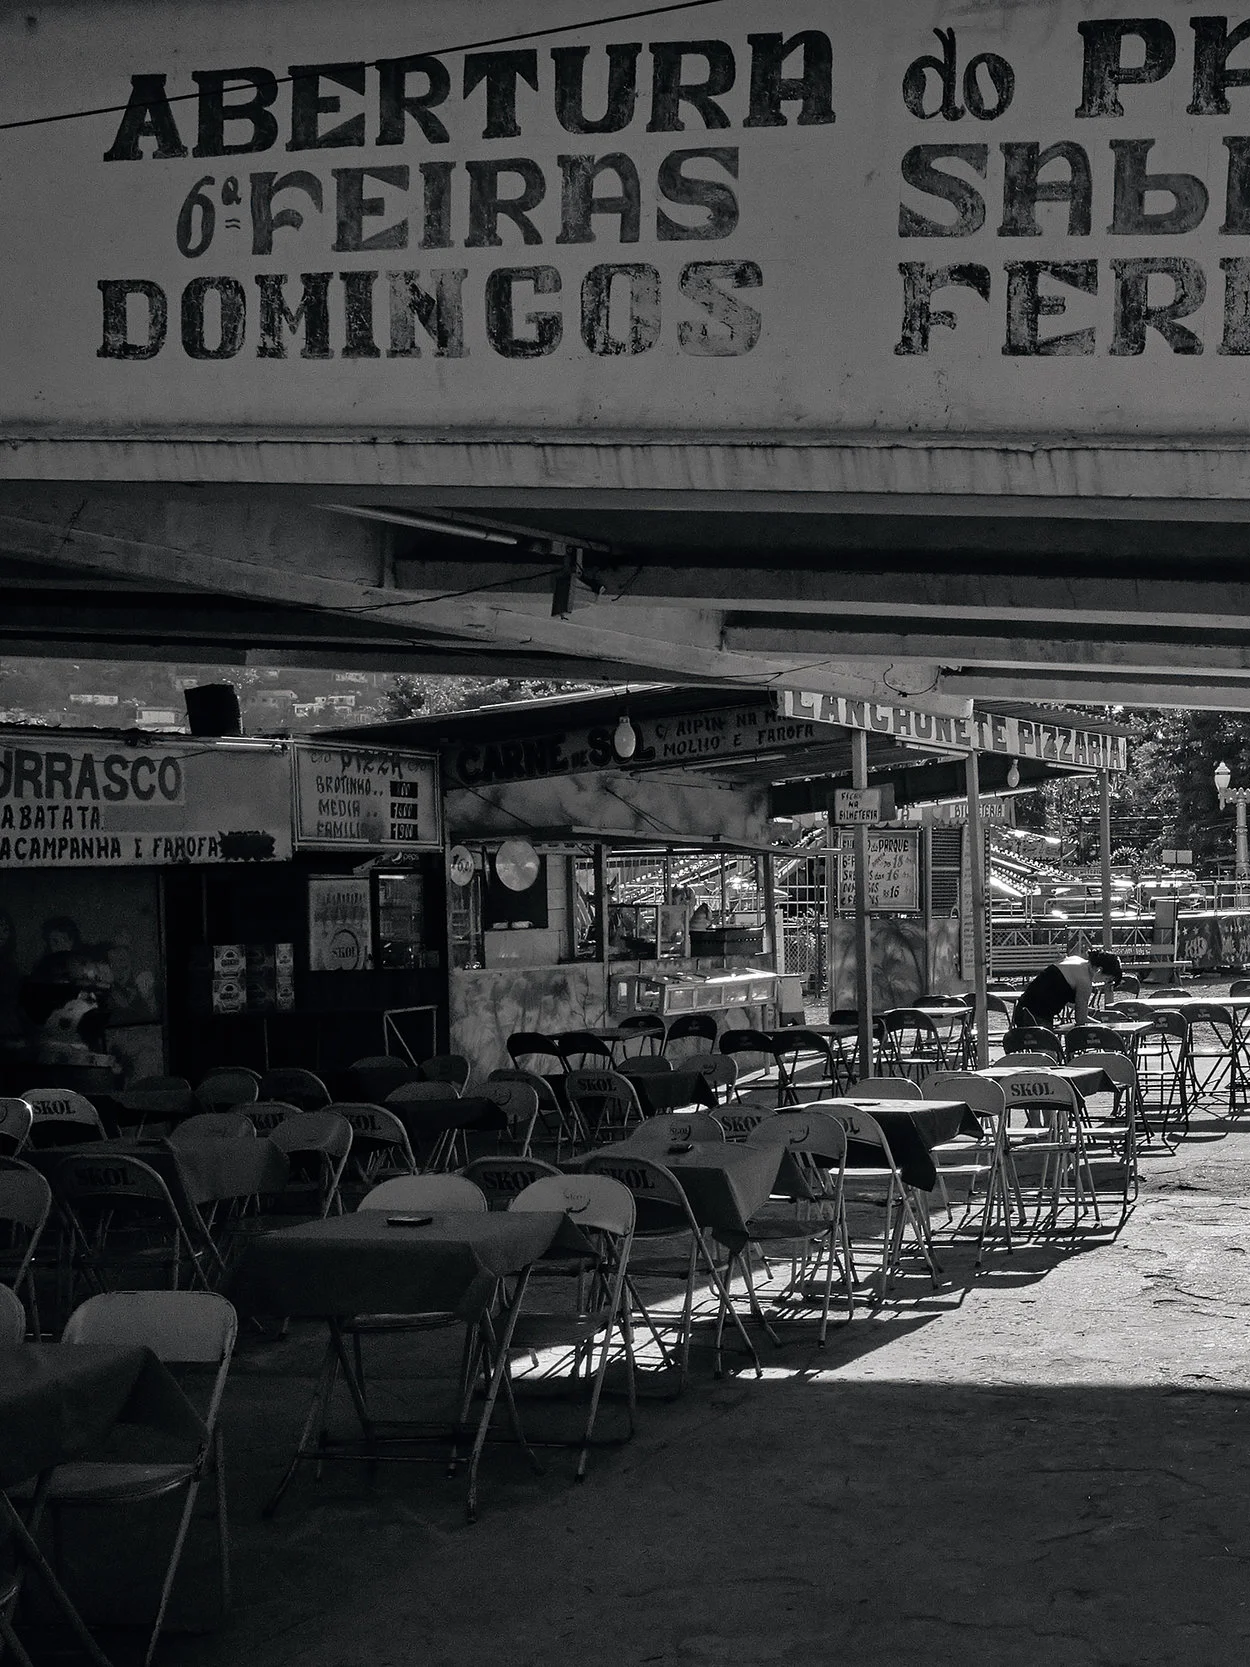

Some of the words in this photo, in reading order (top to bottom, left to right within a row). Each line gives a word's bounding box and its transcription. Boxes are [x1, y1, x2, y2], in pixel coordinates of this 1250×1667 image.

[104, 29, 836, 161] ABERTURA
[902, 27, 1015, 121] do
[96, 260, 763, 360] DOMINGOS
[736, 711, 757, 728] NA
[588, 724, 656, 767] SL
[733, 733, 742, 748] E
[1018, 720, 1121, 769] PIZZARIA
[879, 839, 909, 853] PARQUE
[577, 1078, 616, 1091] SKOL
[1010, 1082, 1055, 1097] SKOL
[33, 1100, 76, 1114] SKOL
[74, 1167, 136, 1186] SKOL
